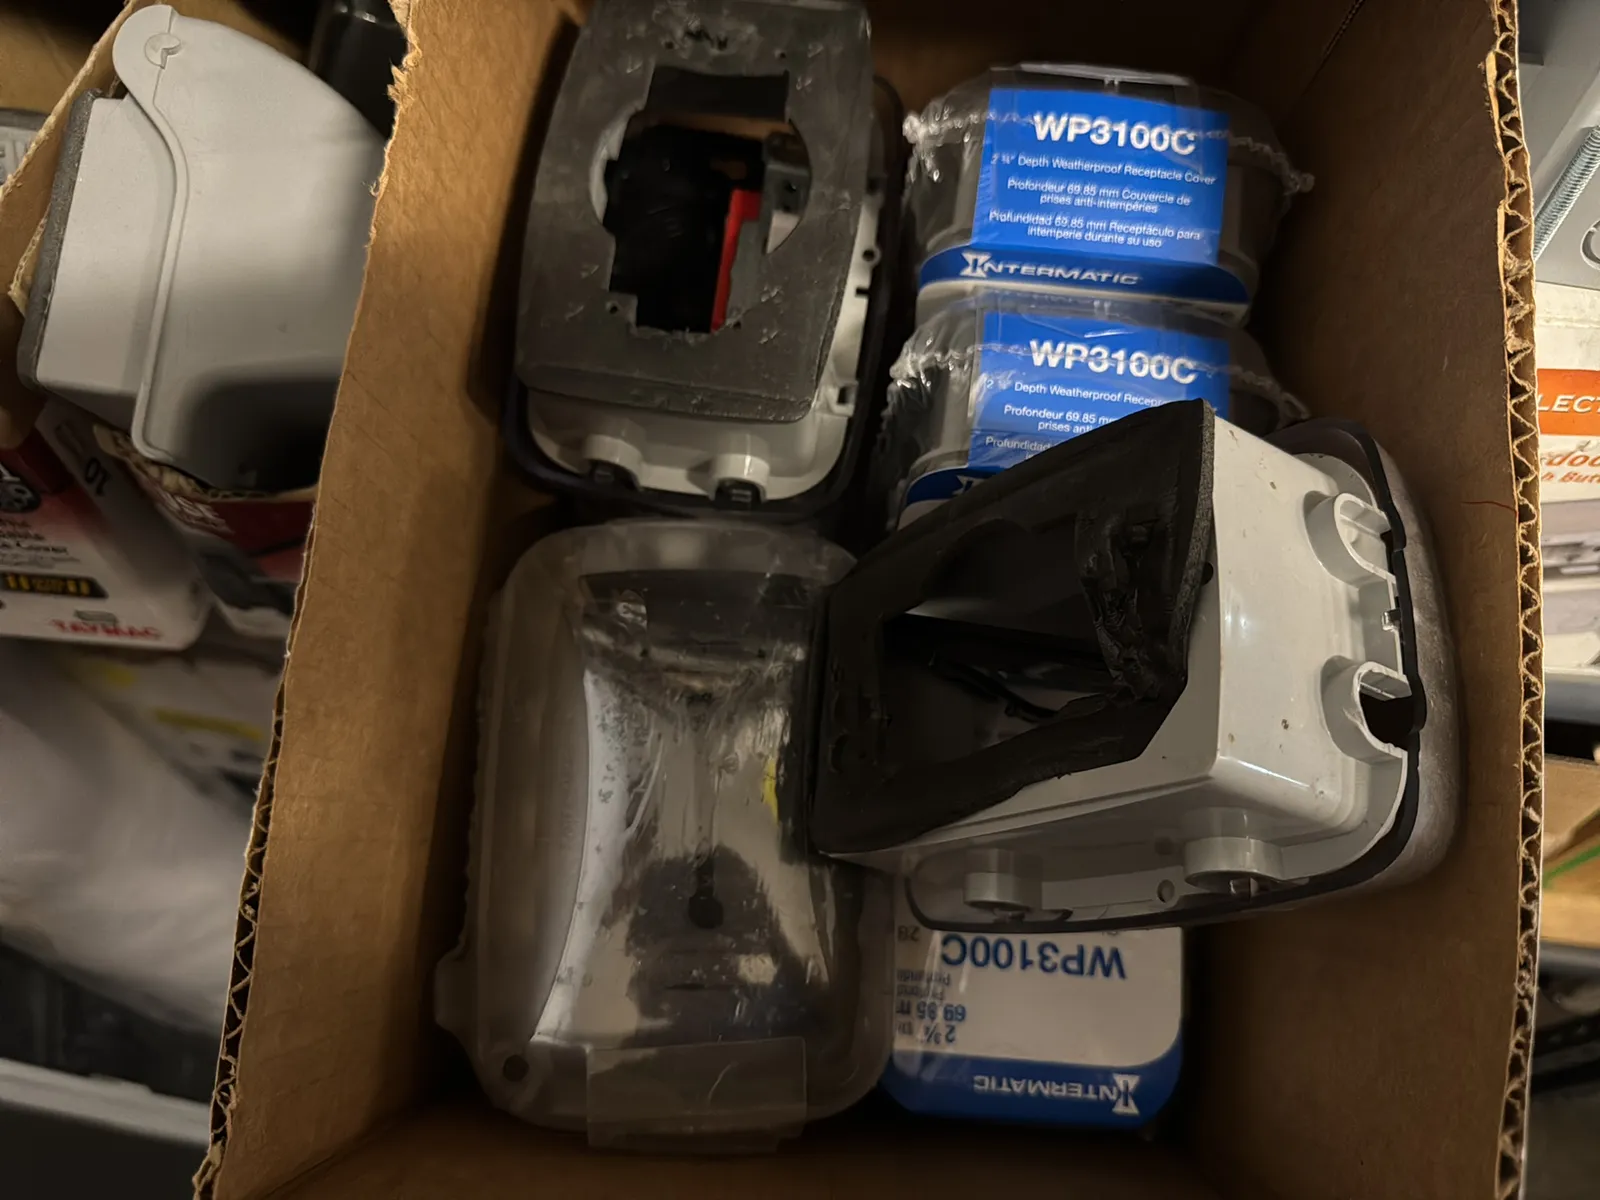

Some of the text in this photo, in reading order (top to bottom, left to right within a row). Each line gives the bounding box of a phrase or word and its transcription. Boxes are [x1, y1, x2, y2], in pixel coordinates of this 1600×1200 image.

[1033, 112, 1197, 155] WP3100C
[1018, 153, 1049, 168] Depth
[1052, 157, 1123, 176] Weatherproof
[1124, 163, 1182, 182] Receptacle
[1184, 171, 1216, 185] Cover
[1007, 177, 1191, 206] Profondeur 69.85 mm Couvercle de
[1040, 194, 1158, 214] prises anti-intempéries
[989, 209, 1201, 243] Profundidad 69.85 mm Receptáculo para
[1028, 226, 1162, 248] intemperie durante su uso
[1030, 339, 1198, 384] WP3100C
[1014, 381, 1048, 397] Depth
[1050, 385, 1121, 404] Weatherproof
[1123, 394, 1167, 407] Recep
[1003, 404, 1063, 421] Profondeur
[1065, 410, 1096, 425] 69.85
[1037, 419, 1071, 434] prises
[941, 933, 1127, 980] WP3100C
